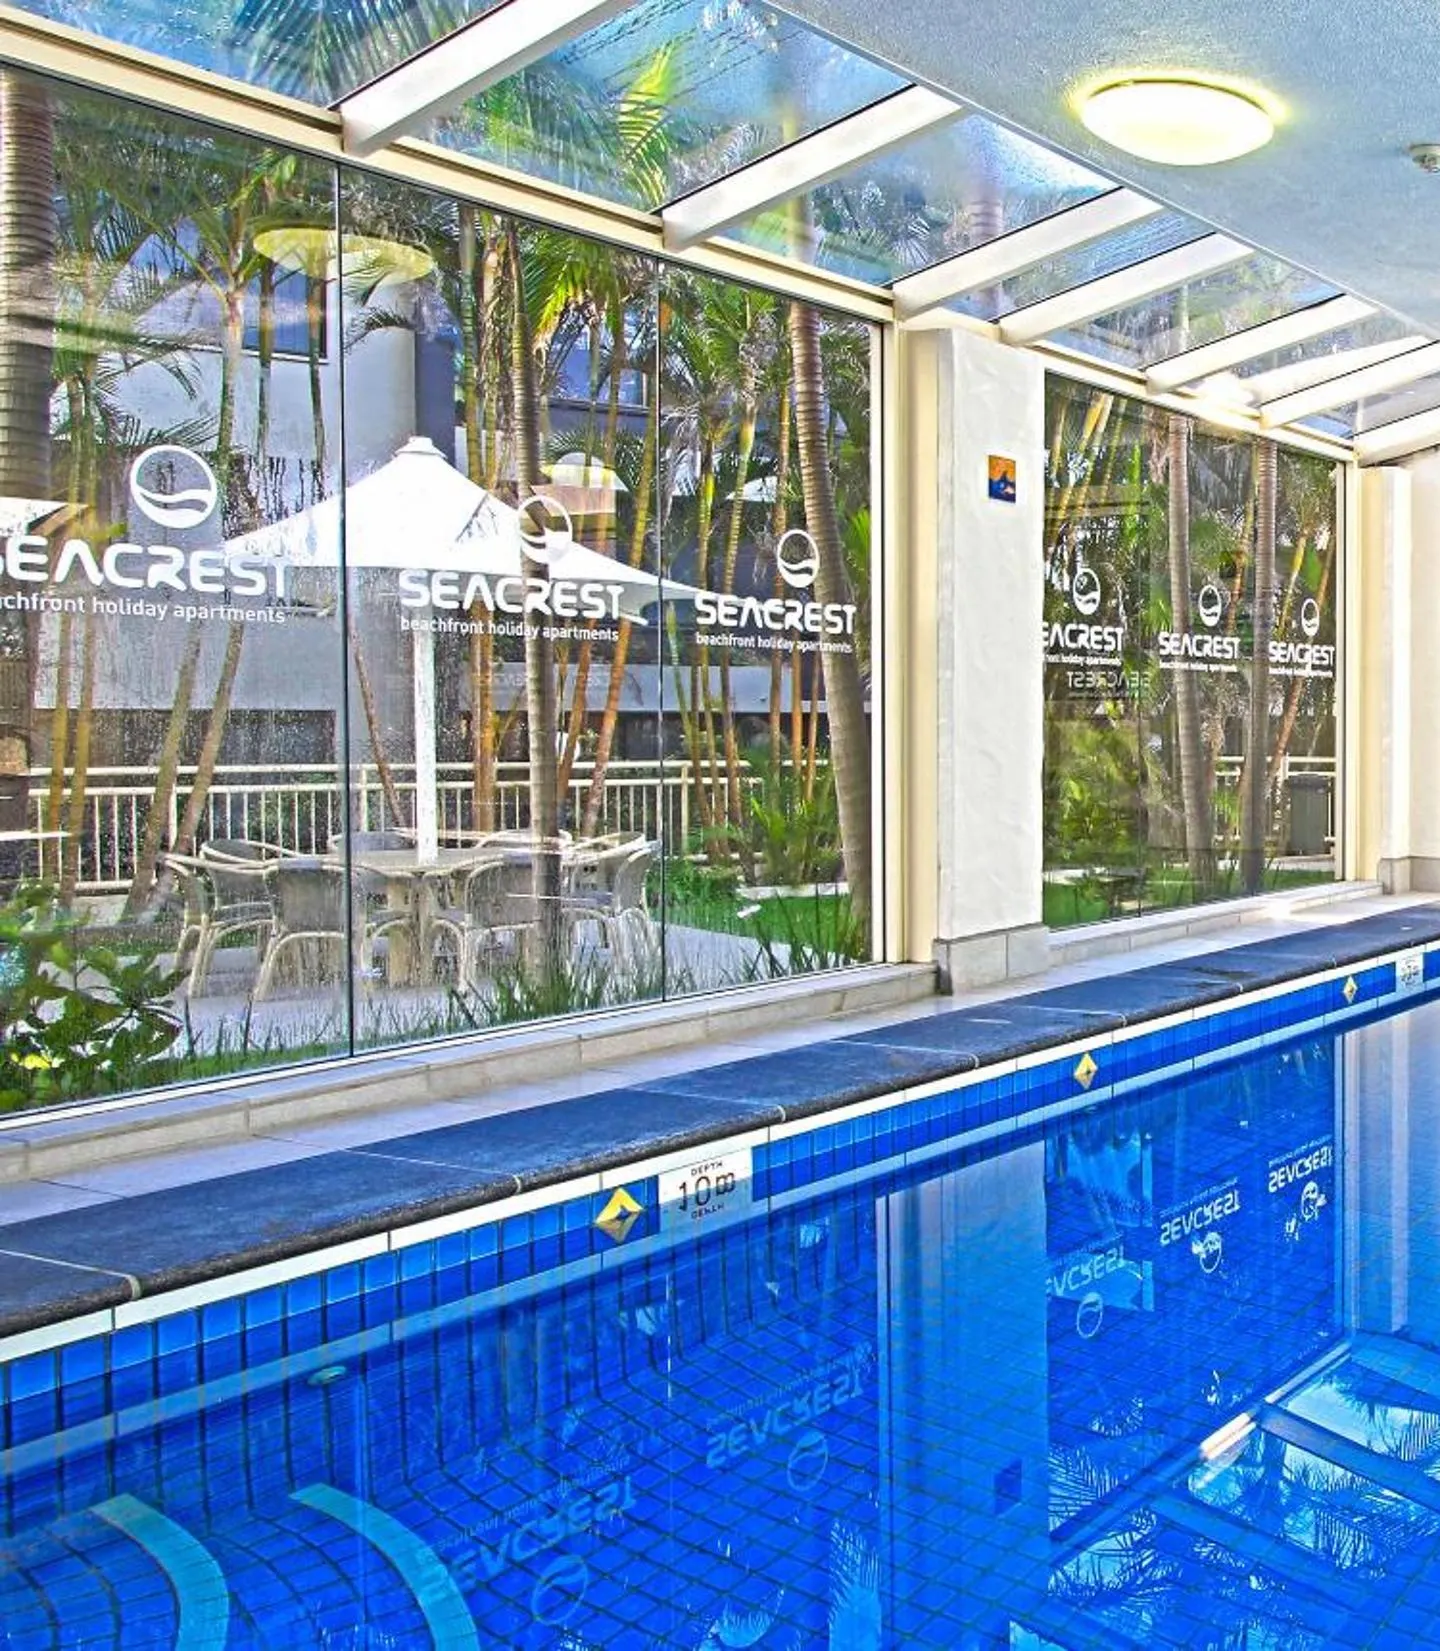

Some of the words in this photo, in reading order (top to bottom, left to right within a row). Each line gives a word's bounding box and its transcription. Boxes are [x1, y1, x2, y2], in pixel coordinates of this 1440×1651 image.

[0, 535, 288, 598] EACREST
[0, 591, 86, 613] chfront
[93, 595, 168, 621] holiday
[174, 602, 286, 624] apartments
[399, 569, 624, 620] SEACREST
[694, 591, 857, 635] SEACREST
[400, 616, 485, 635] beachfront
[488, 621, 538, 639] holiday
[542, 626, 619, 643] apartments
[696, 632, 756, 648] beachfront
[1158, 631, 1241, 659] SEACREST
[1268, 640, 1335, 666] SEACREST
[690, 1159, 724, 1177] DEPTH
